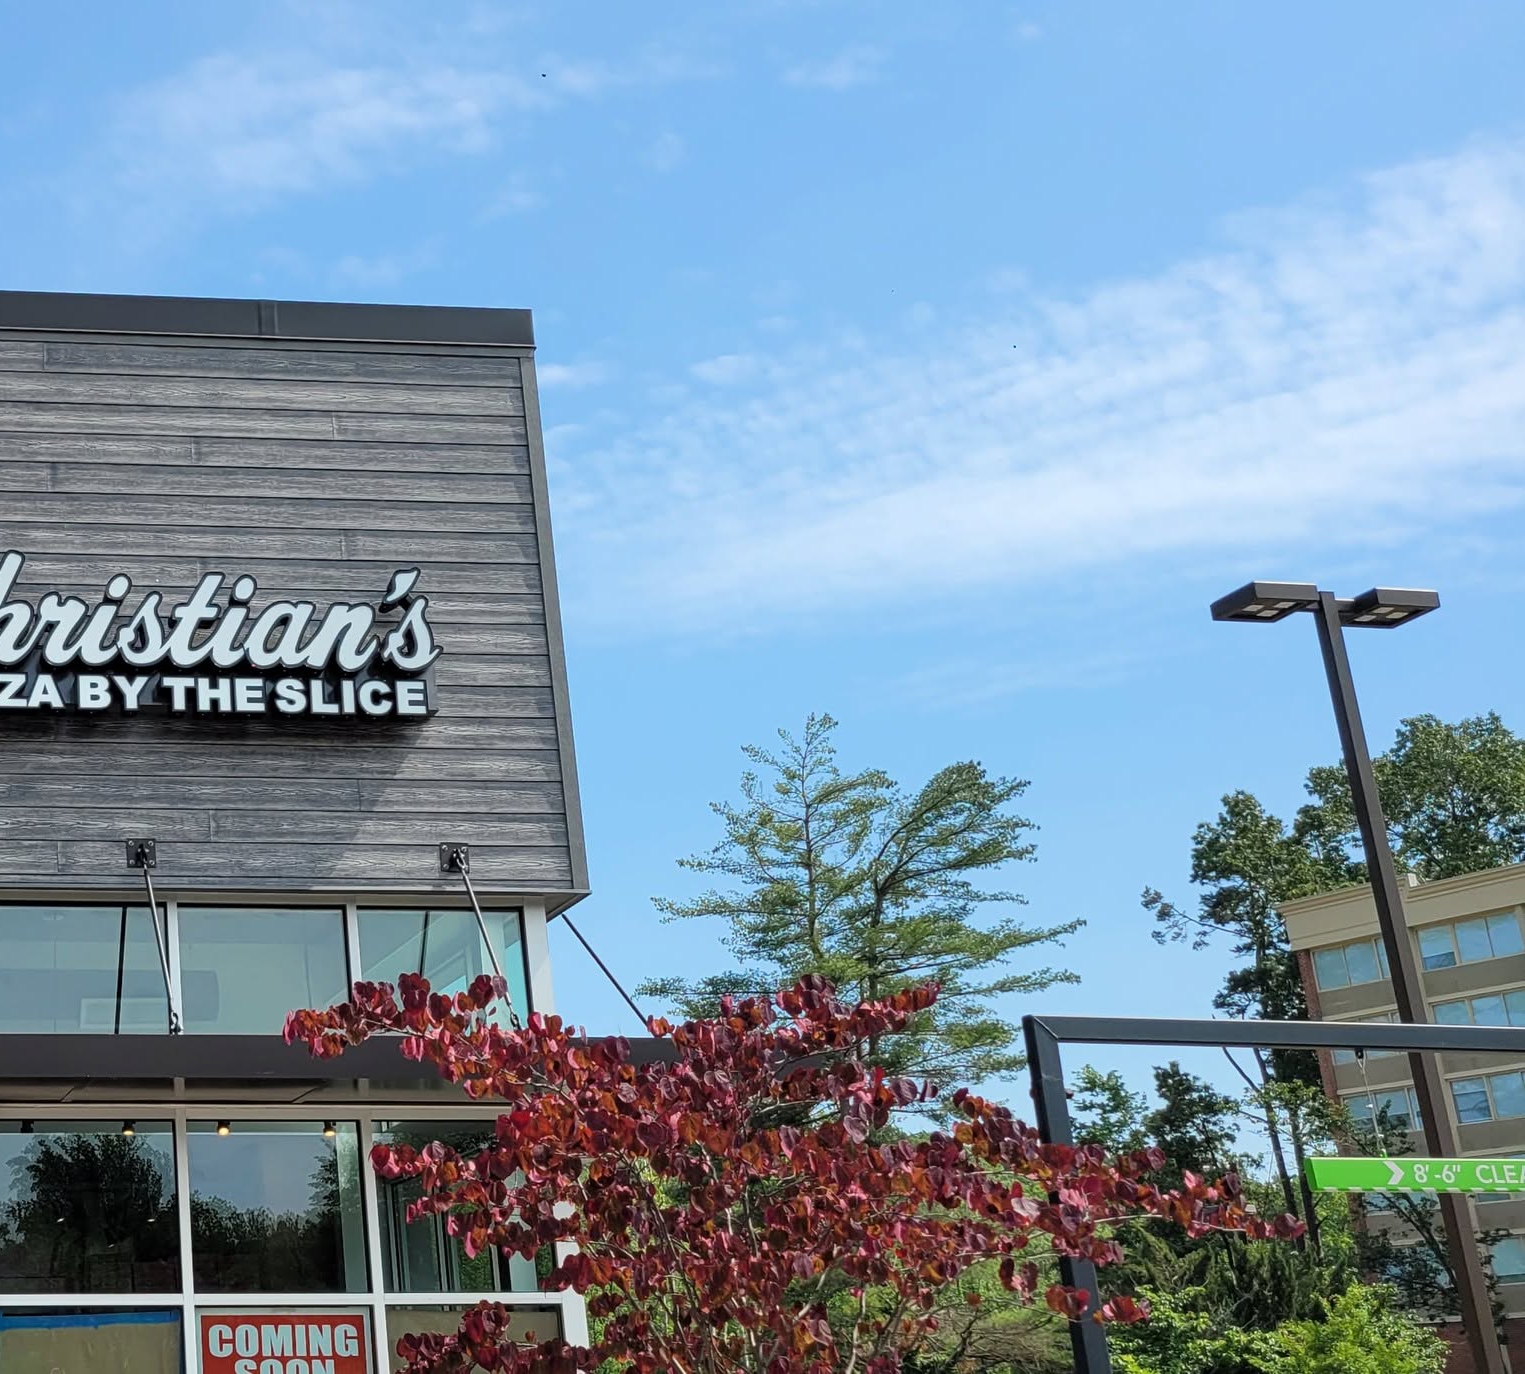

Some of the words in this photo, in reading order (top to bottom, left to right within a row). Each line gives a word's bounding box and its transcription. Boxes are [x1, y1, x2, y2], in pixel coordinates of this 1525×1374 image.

[78, 675, 150, 710] BY
[162, 676, 266, 713] THE
[275, 678, 427, 715] SLICE
[208, 1323, 360, 1358] COMING
